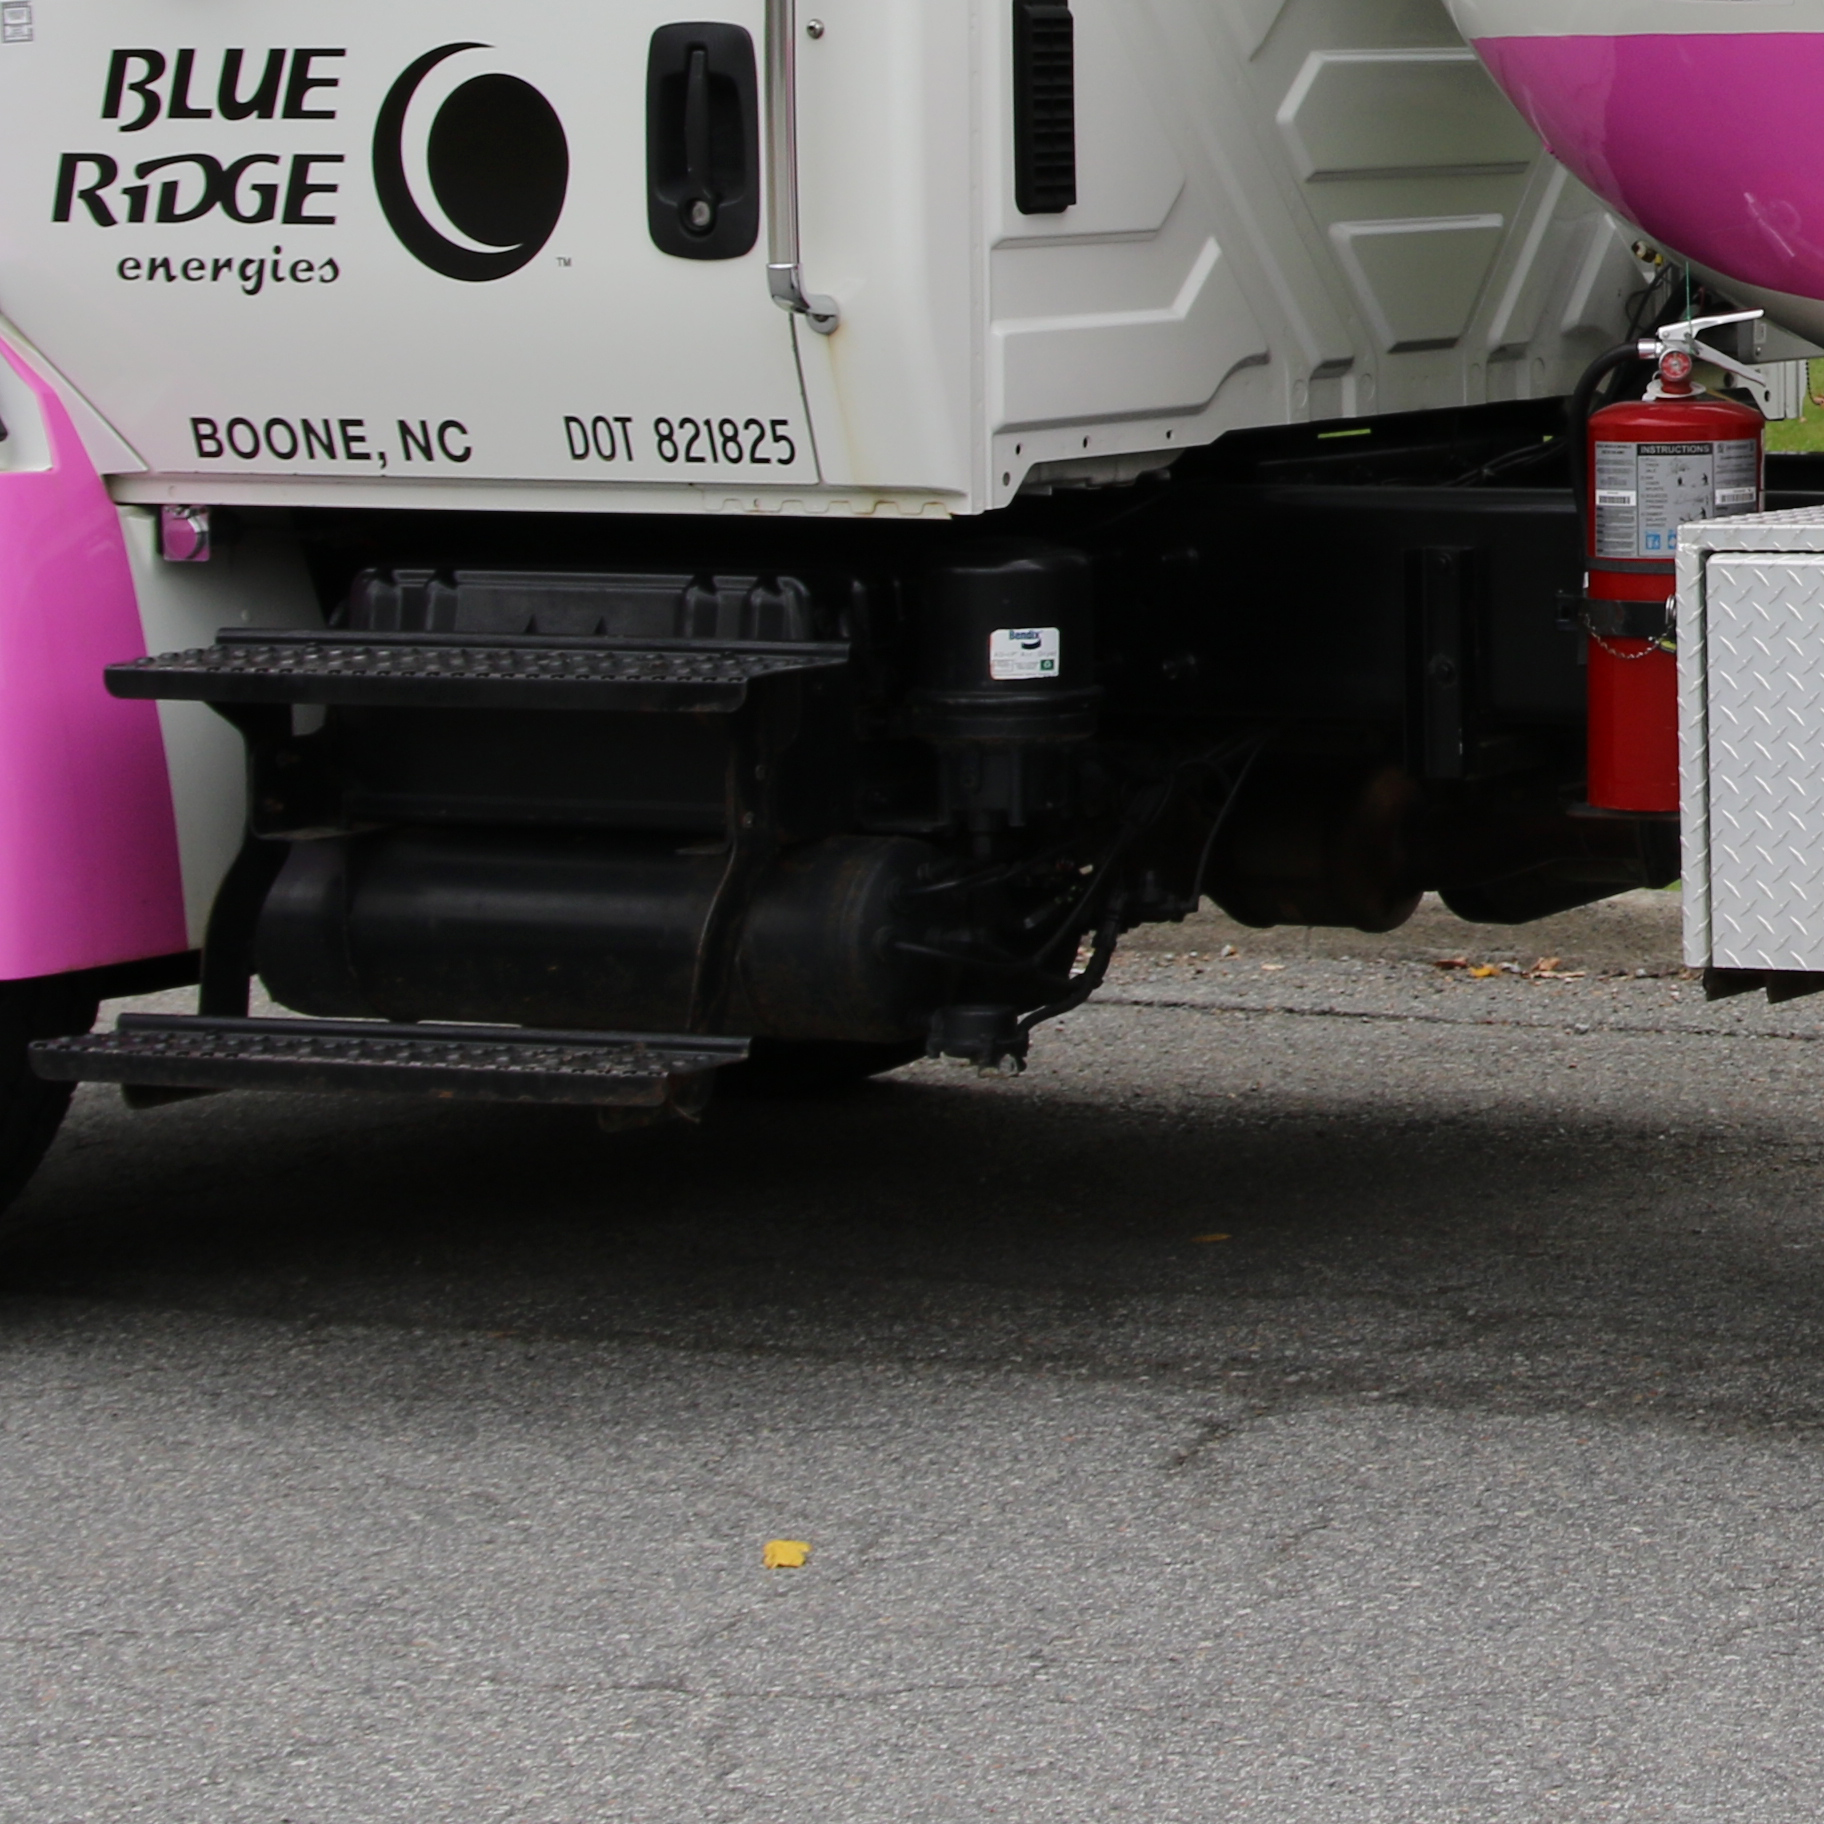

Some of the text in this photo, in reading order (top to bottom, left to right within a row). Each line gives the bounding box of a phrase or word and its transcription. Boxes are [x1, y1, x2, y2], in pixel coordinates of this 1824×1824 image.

[102, 49, 346, 132] BLUE
[52, 152, 345, 227] RIDGE
[117, 246, 339, 296] energies
[190, 418, 472, 469] BOONE, NC
[563, 416, 796, 466] DOT 821825
[1640, 444, 1710, 454] INSTRUCTIONS
